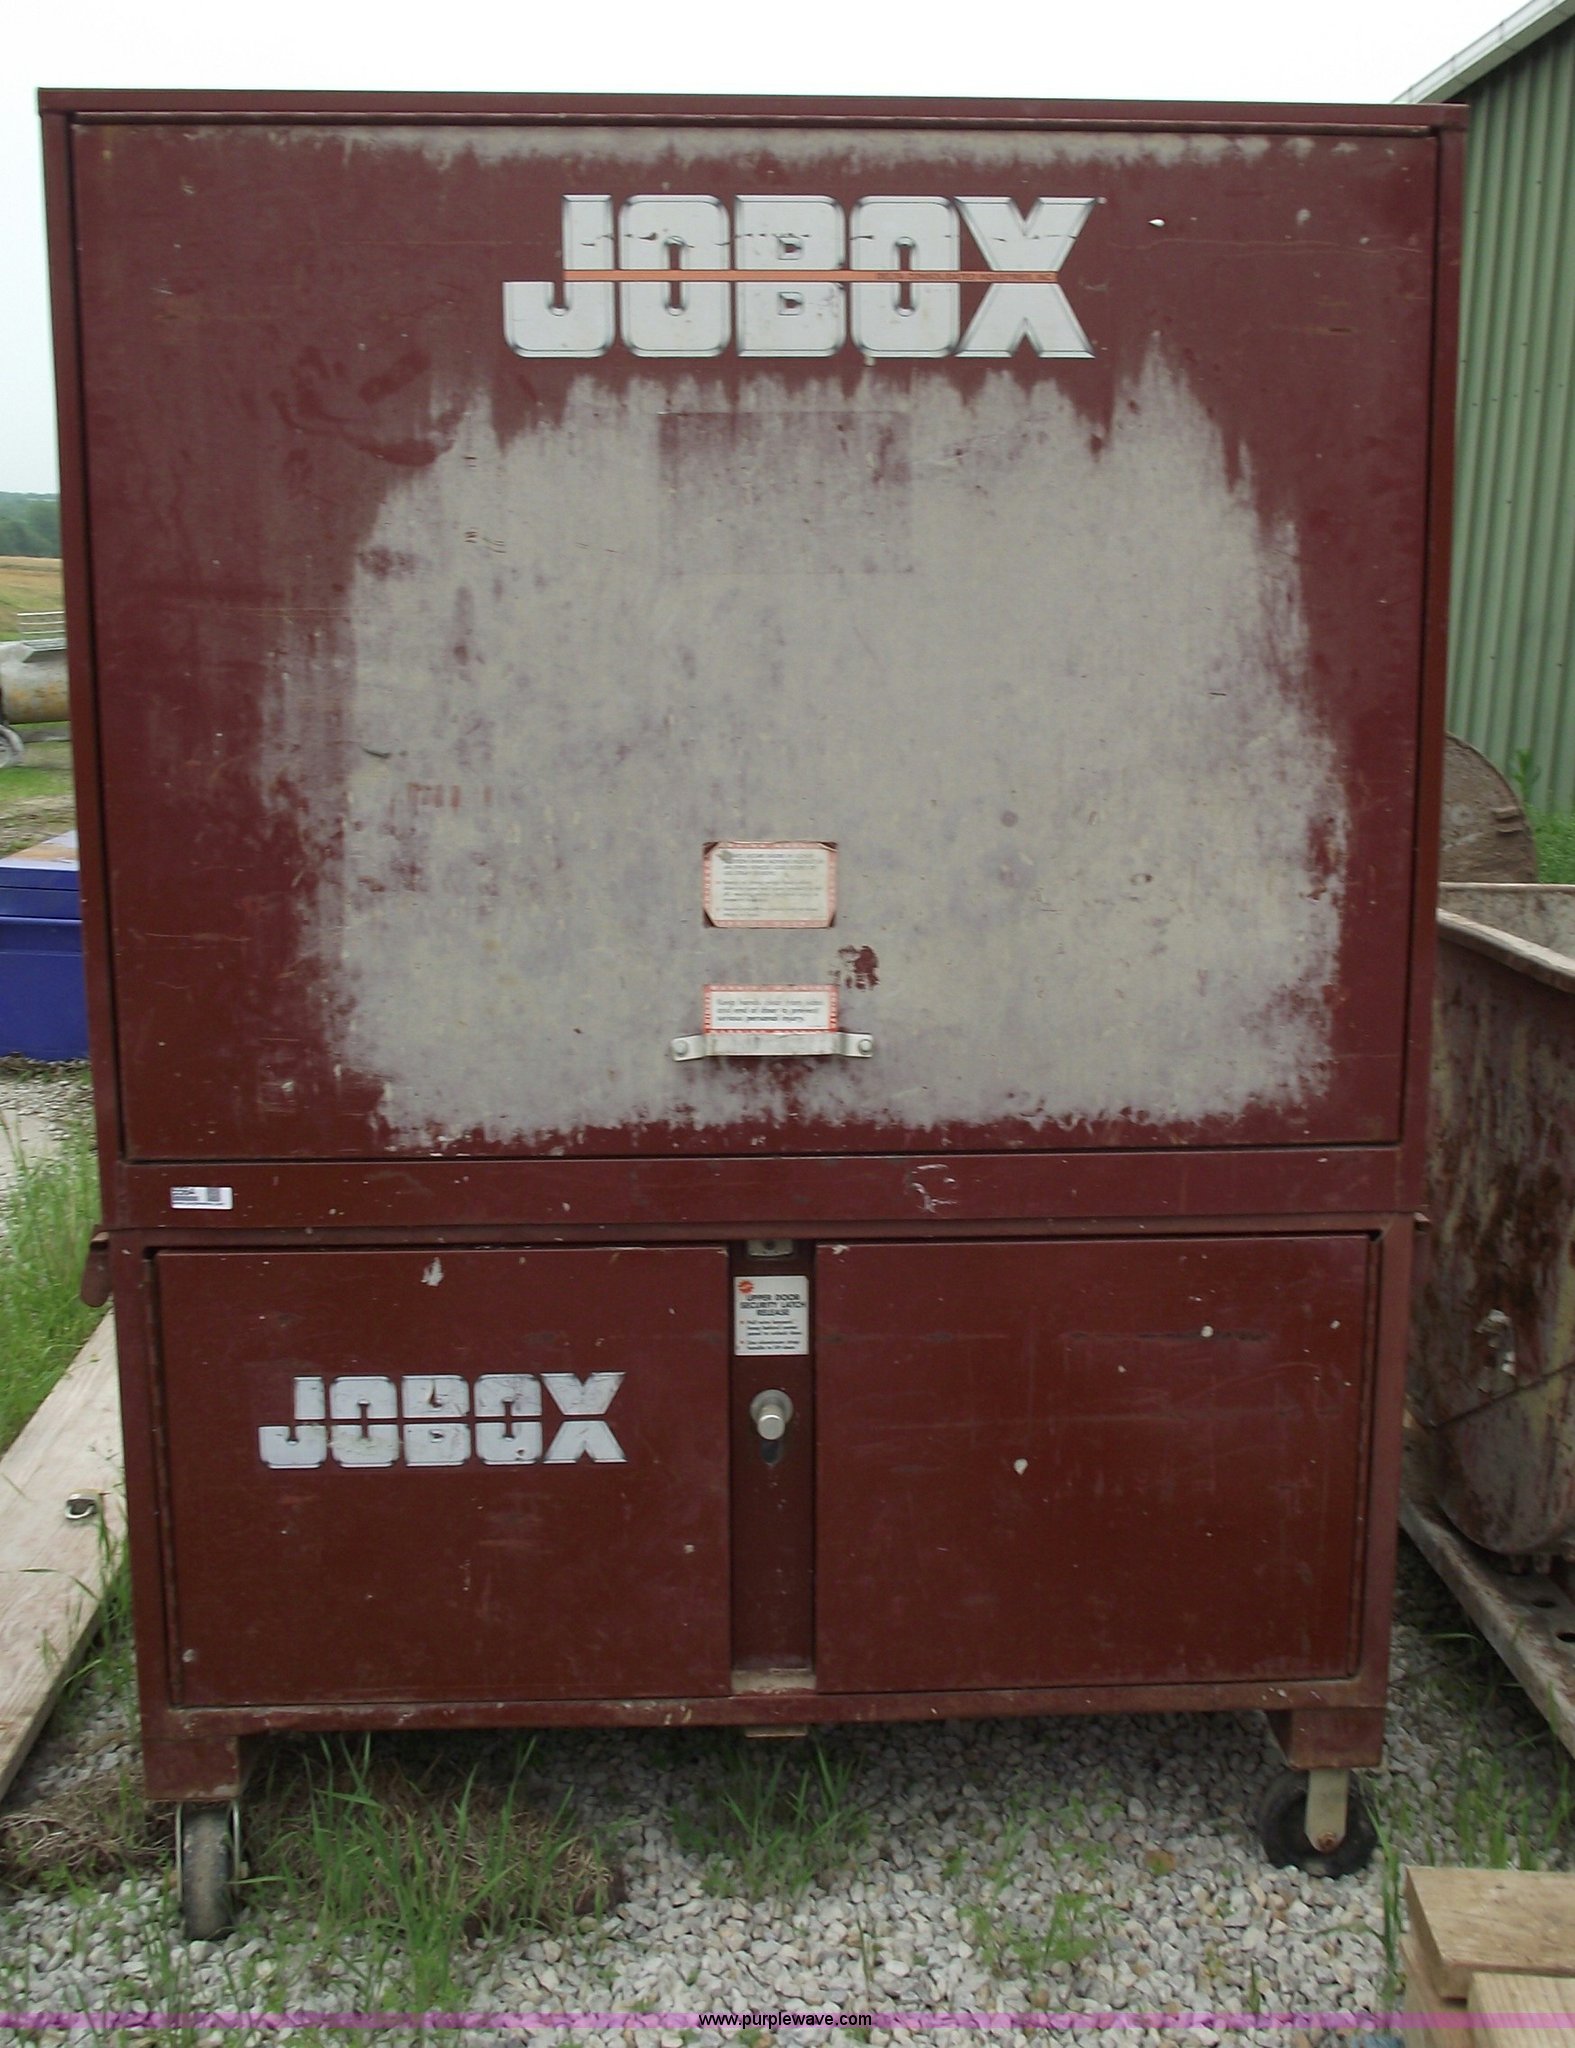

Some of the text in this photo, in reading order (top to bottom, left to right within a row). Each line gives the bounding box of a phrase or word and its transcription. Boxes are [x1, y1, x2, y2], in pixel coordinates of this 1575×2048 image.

[502, 193, 1098, 360] JOBOX
[740, 1301, 777, 1309] SECURITY
[258, 1371, 628, 1469] JOBOX
